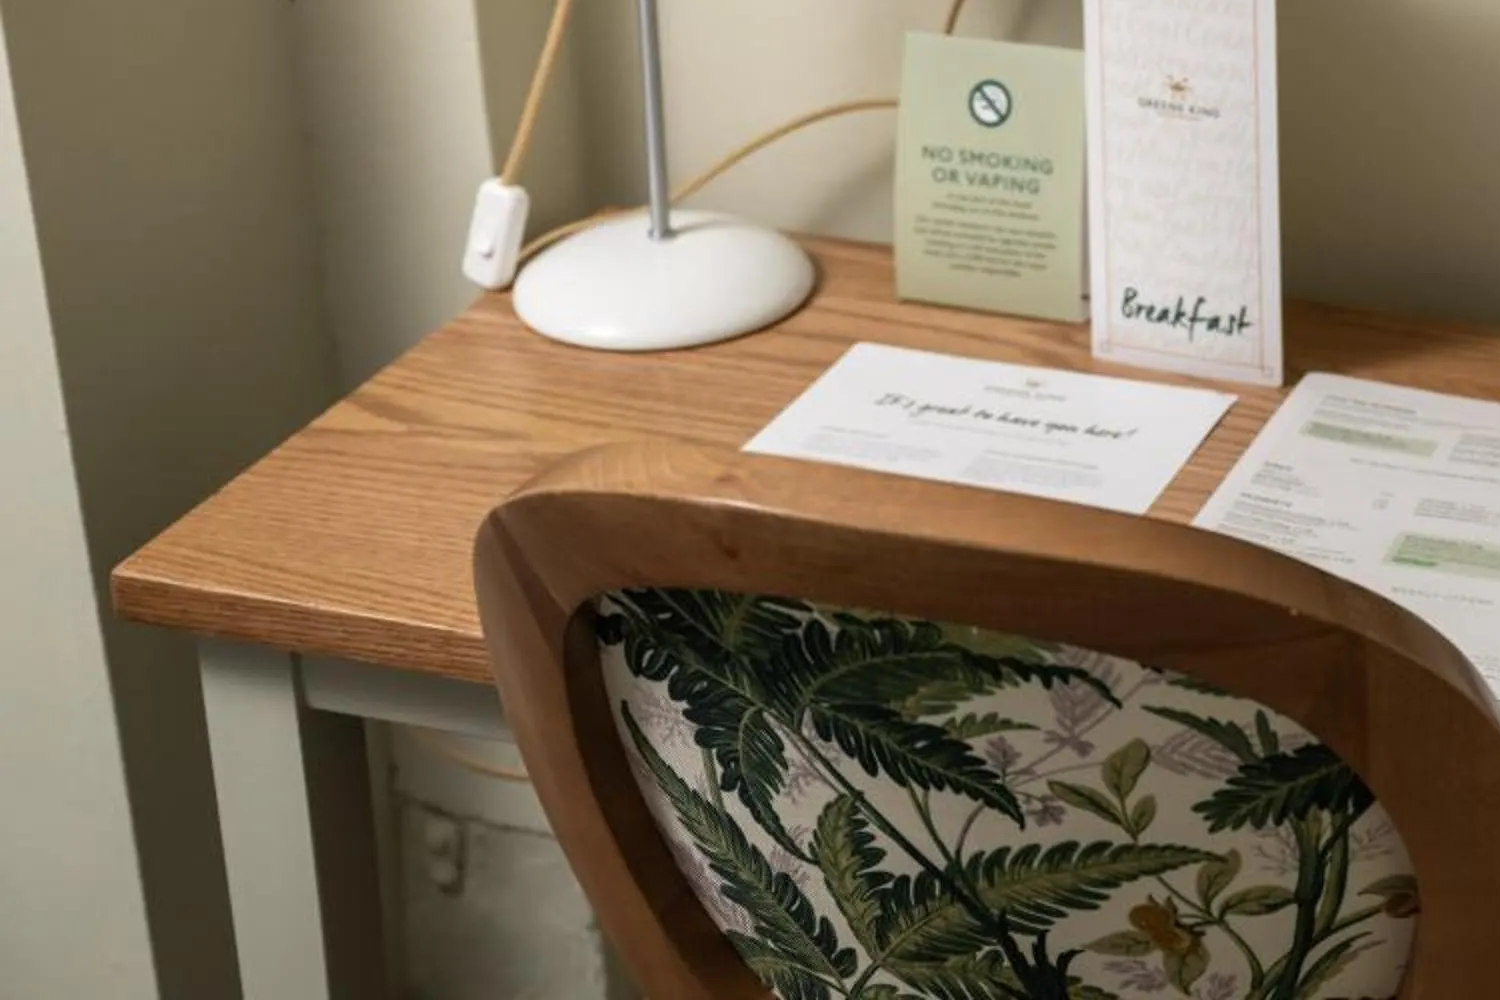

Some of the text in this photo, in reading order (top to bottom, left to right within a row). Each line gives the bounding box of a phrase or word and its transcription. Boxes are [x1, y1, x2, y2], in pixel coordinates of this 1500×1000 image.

[921, 145, 1053, 176] NO SMOKING
[931, 166, 1041, 195] OR VAPING
[1120, 286, 1253, 342] Breakfast
